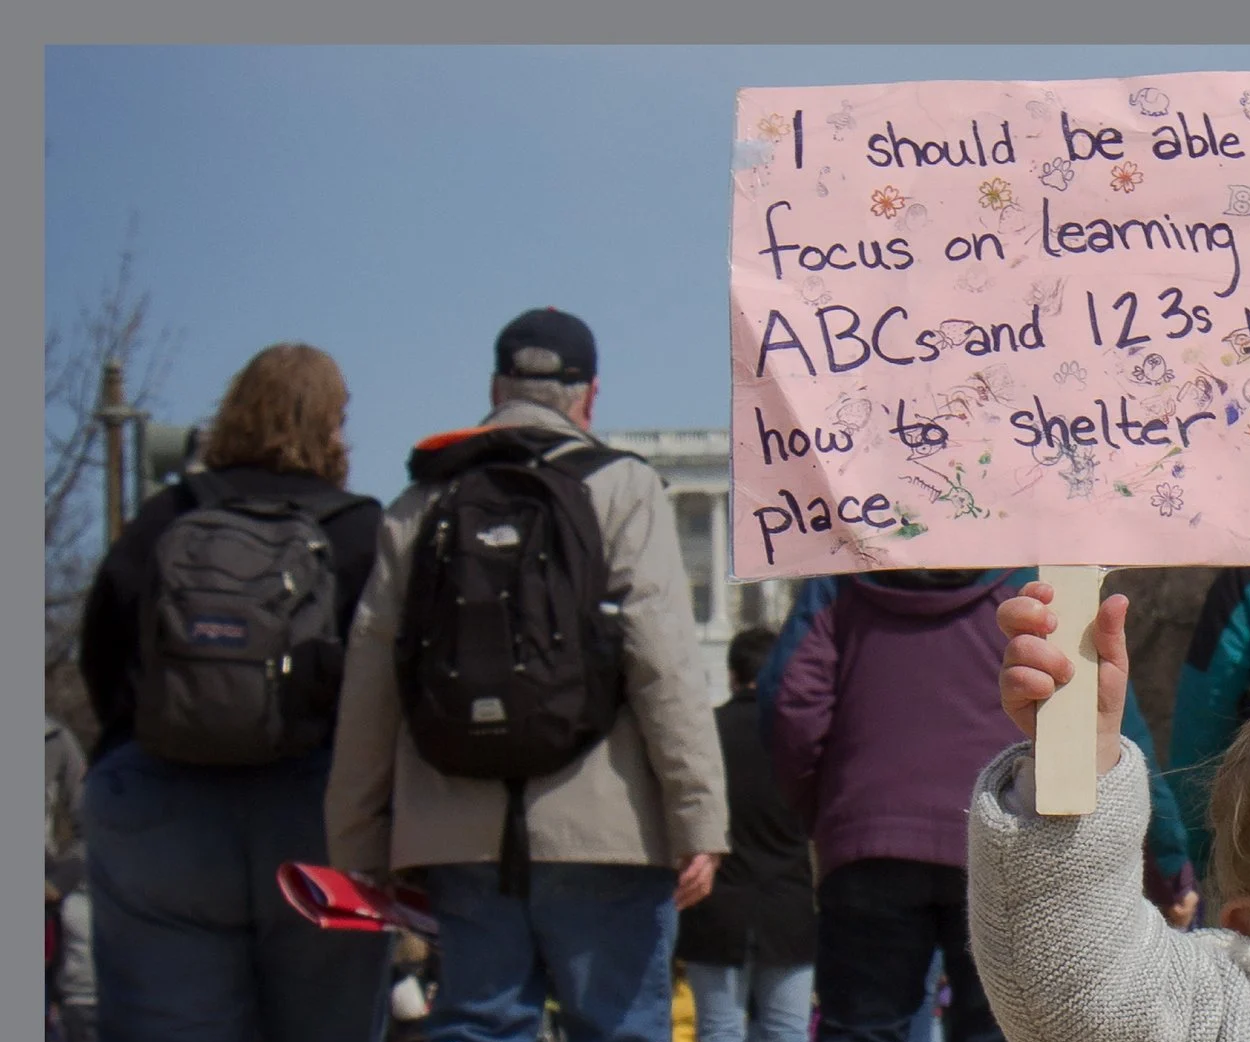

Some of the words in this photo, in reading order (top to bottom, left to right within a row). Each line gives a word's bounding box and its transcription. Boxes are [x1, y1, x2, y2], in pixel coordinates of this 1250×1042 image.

[792, 109, 803, 169] I
[866, 119, 1016, 168] should
[1060, 111, 1124, 163] be
[1151, 112, 1246, 161] able
[758, 200, 914, 280] focus
[944, 232, 1004, 262] on
[1042, 197, 1240, 298] learning
[755, 305, 942, 378] ABCs
[964, 304, 1045, 356] and
[1087, 287, 1213, 347] 123s
[754, 407, 855, 465] how
[888, 399, 949, 447] to
[1009, 395, 1216, 450] shelter
